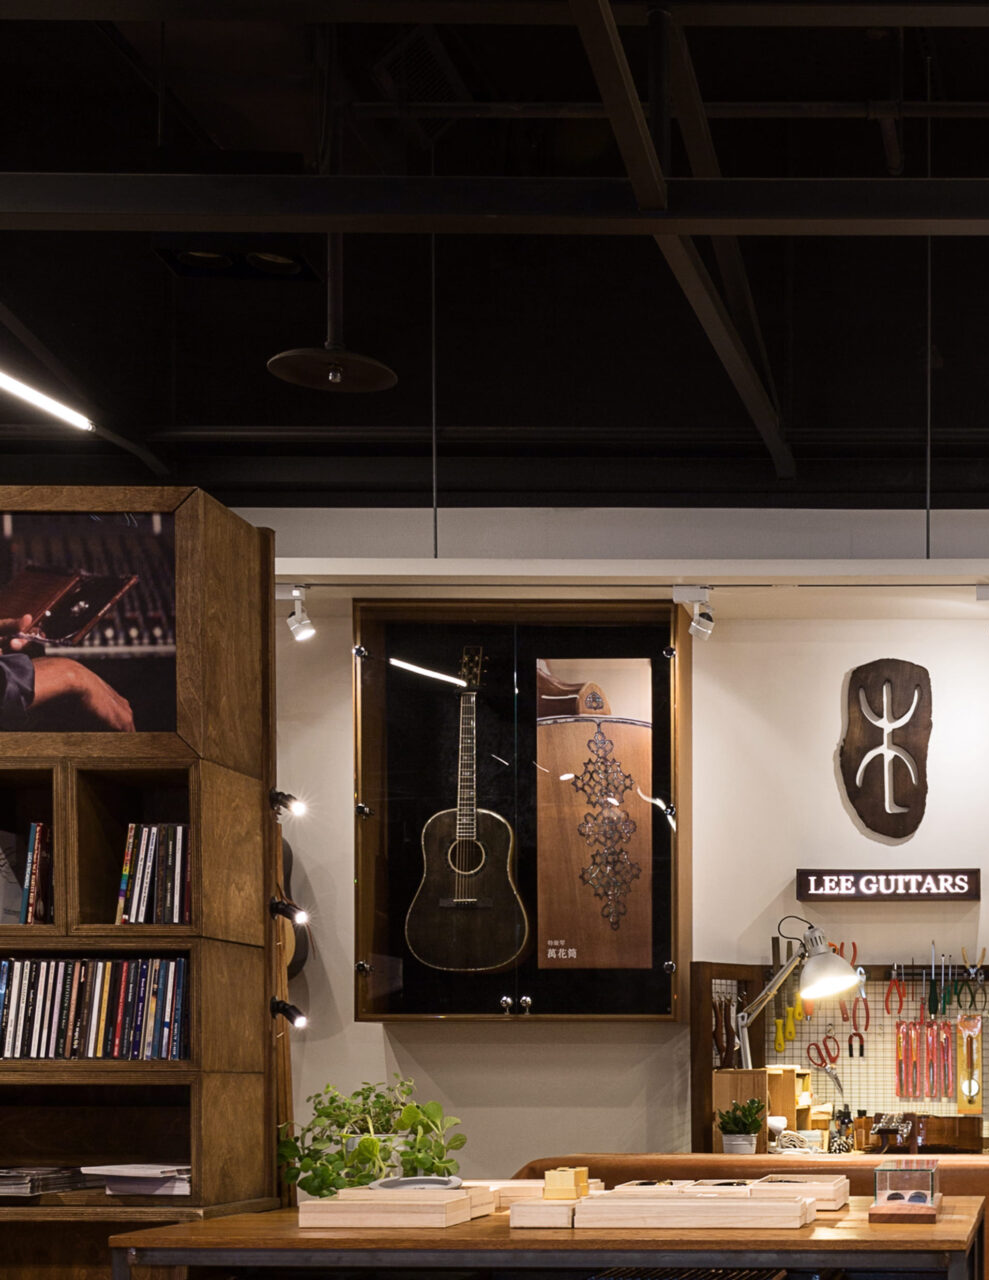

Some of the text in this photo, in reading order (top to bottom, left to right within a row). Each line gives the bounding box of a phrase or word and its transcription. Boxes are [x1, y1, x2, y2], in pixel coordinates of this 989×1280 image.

[808, 875, 969, 894] LEE GUITARS
[547, 948, 577, 959] 萬花筒
